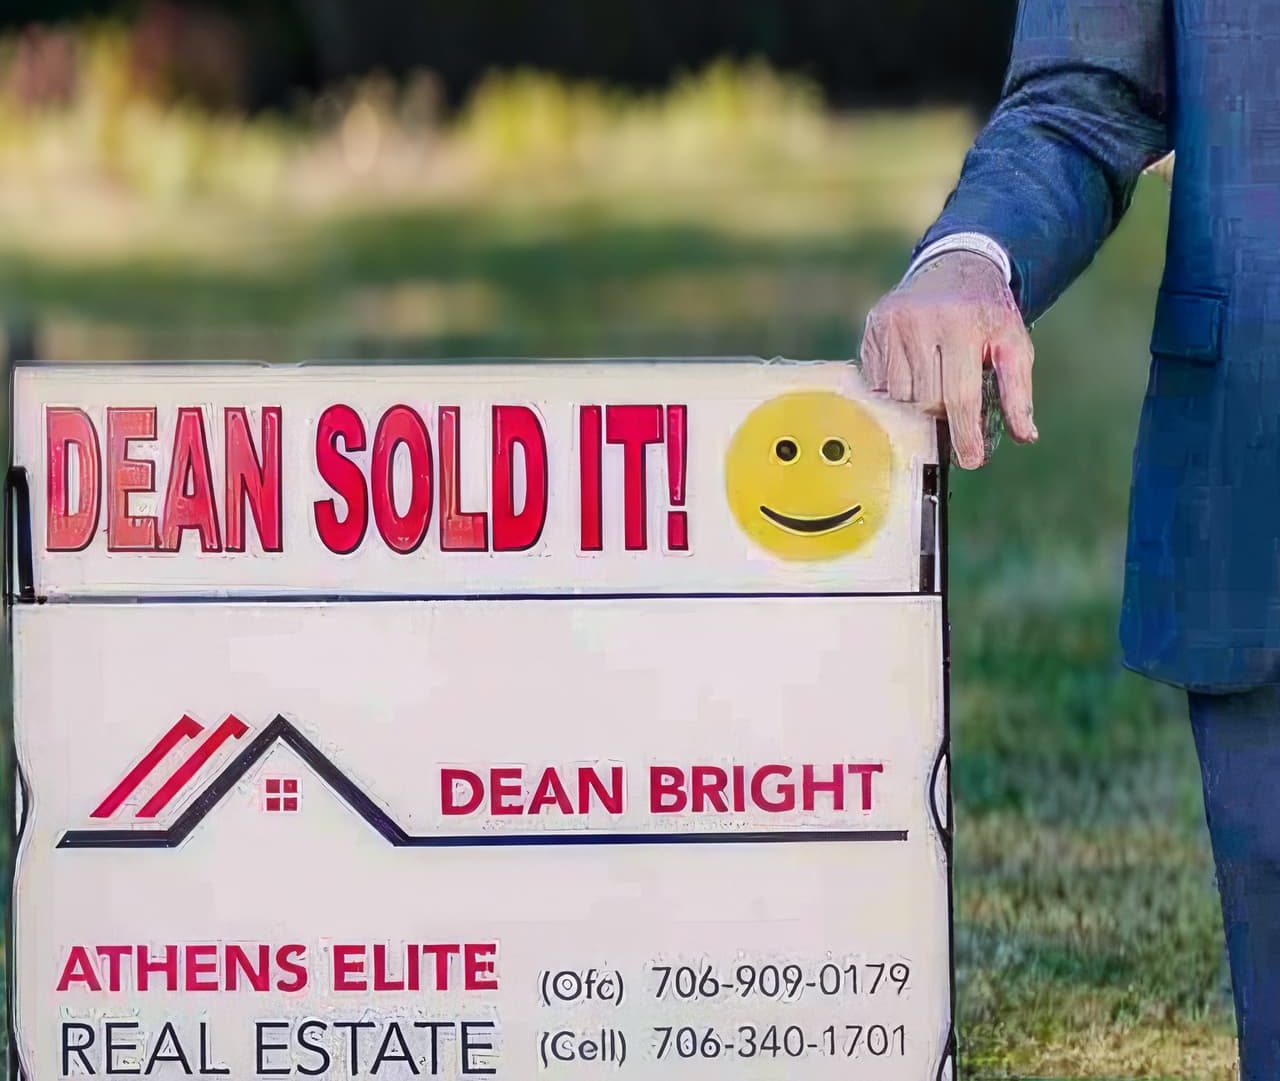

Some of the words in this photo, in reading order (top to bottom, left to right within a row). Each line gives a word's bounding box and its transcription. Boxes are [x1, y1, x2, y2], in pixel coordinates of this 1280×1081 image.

[46, 406, 283, 553] DEAN
[314, 403, 548, 555] SOLD
[579, 404, 688, 552] IT!
[440, 767, 624, 816] DEAN
[649, 763, 884, 814] BRIGHT
[55, 944, 308, 992] ATHENS
[333, 943, 498, 991] ELITE
[541, 968, 624, 1006] (Ofc)
[652, 962, 910, 999] 706-909-0179
[61, 1021, 230, 1076] REAL
[256, 1020, 497, 1076] ESTATE
[540, 1027, 627, 1067] (Cell)
[653, 1024, 906, 1060] 706-340-1701
